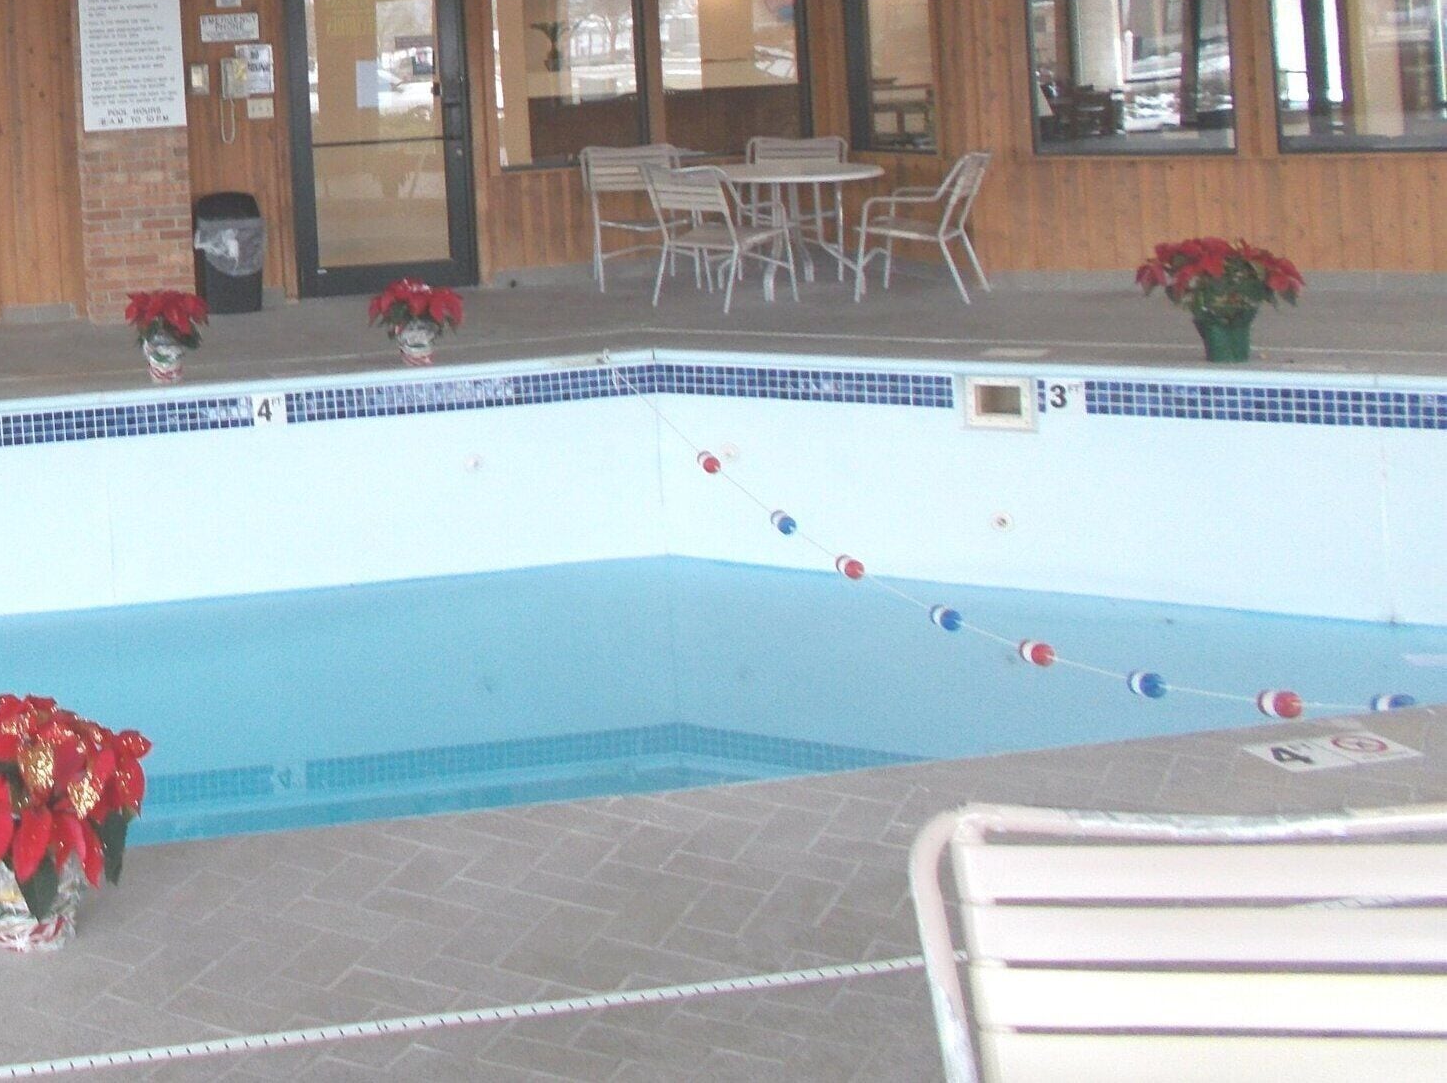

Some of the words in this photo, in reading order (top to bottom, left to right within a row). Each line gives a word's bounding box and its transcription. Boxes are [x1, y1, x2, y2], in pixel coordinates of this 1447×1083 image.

[1050, 384, 1067, 408] 3
[257, 398, 273, 421] 4
[1270, 746, 1315, 764] 4
